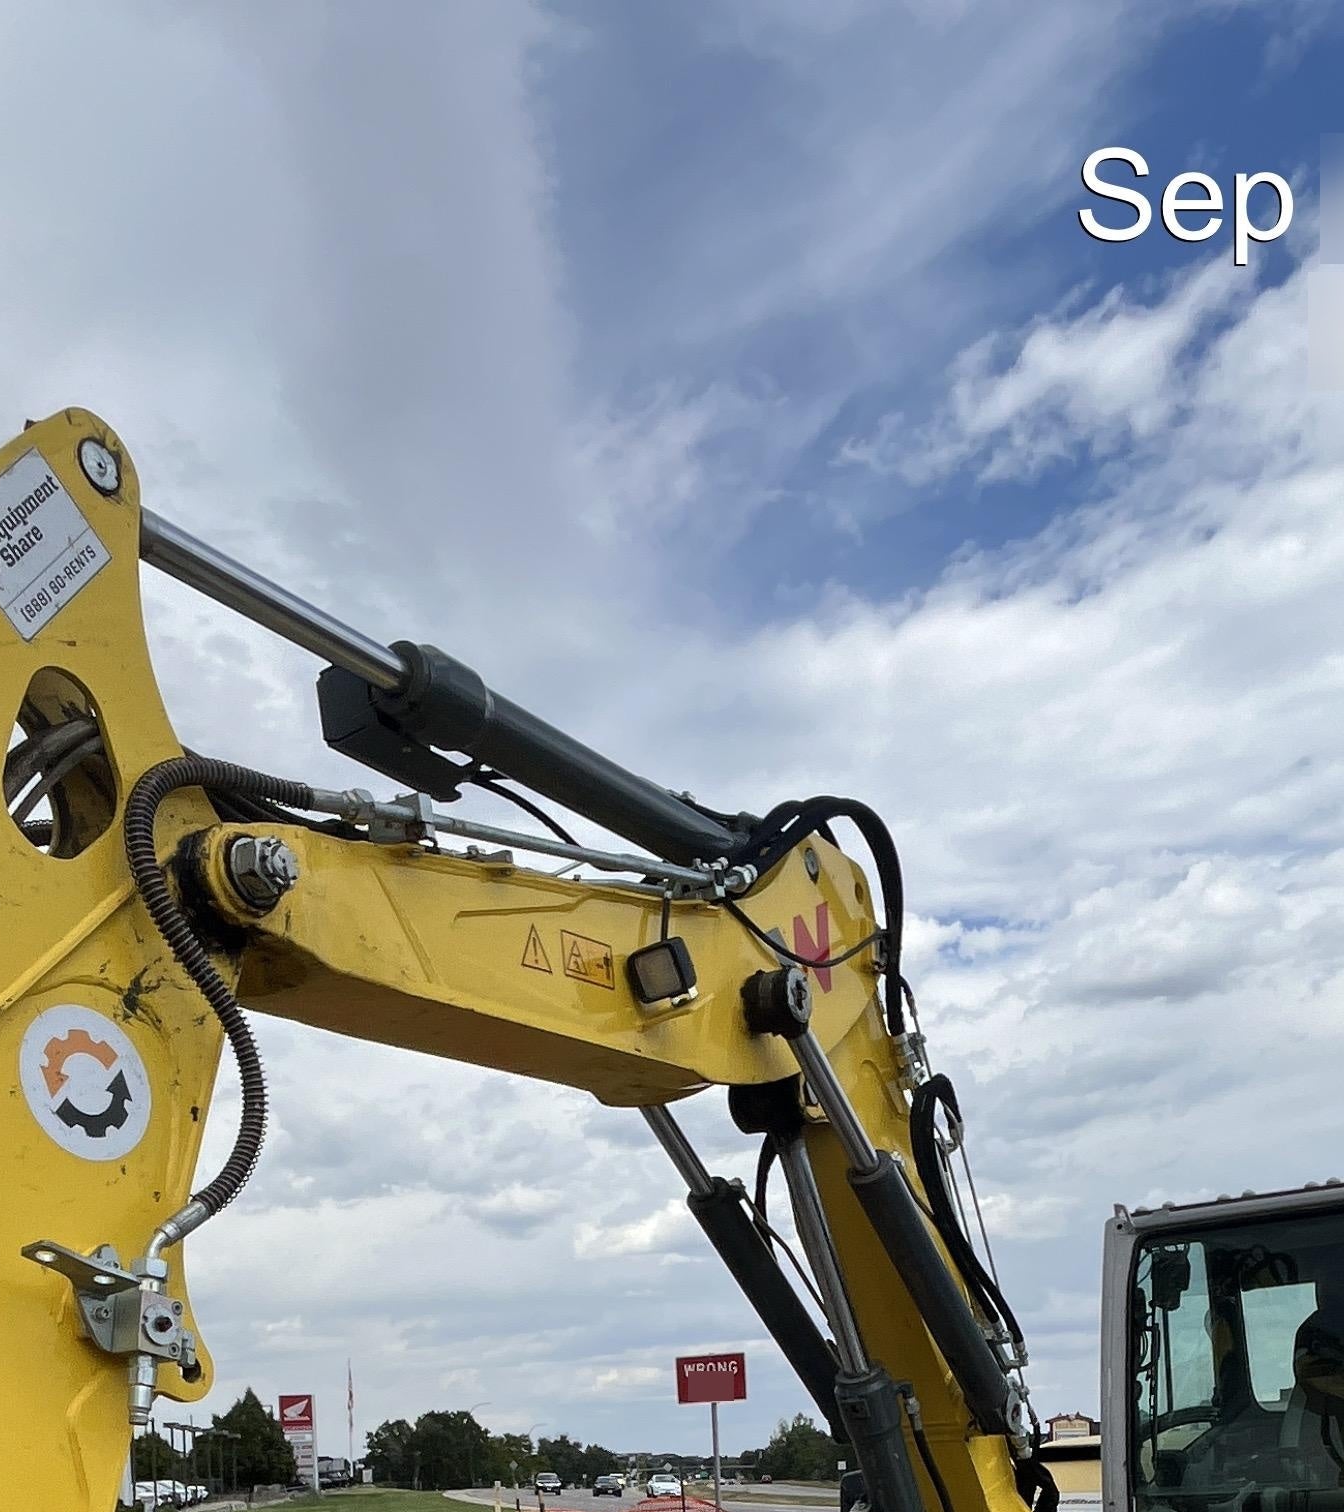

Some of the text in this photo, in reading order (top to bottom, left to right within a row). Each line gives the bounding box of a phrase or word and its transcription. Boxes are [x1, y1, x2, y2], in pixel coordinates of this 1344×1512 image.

[0, 525, 44, 568] Share
[19, 544, 97, 623] (888) 80-RENTS
